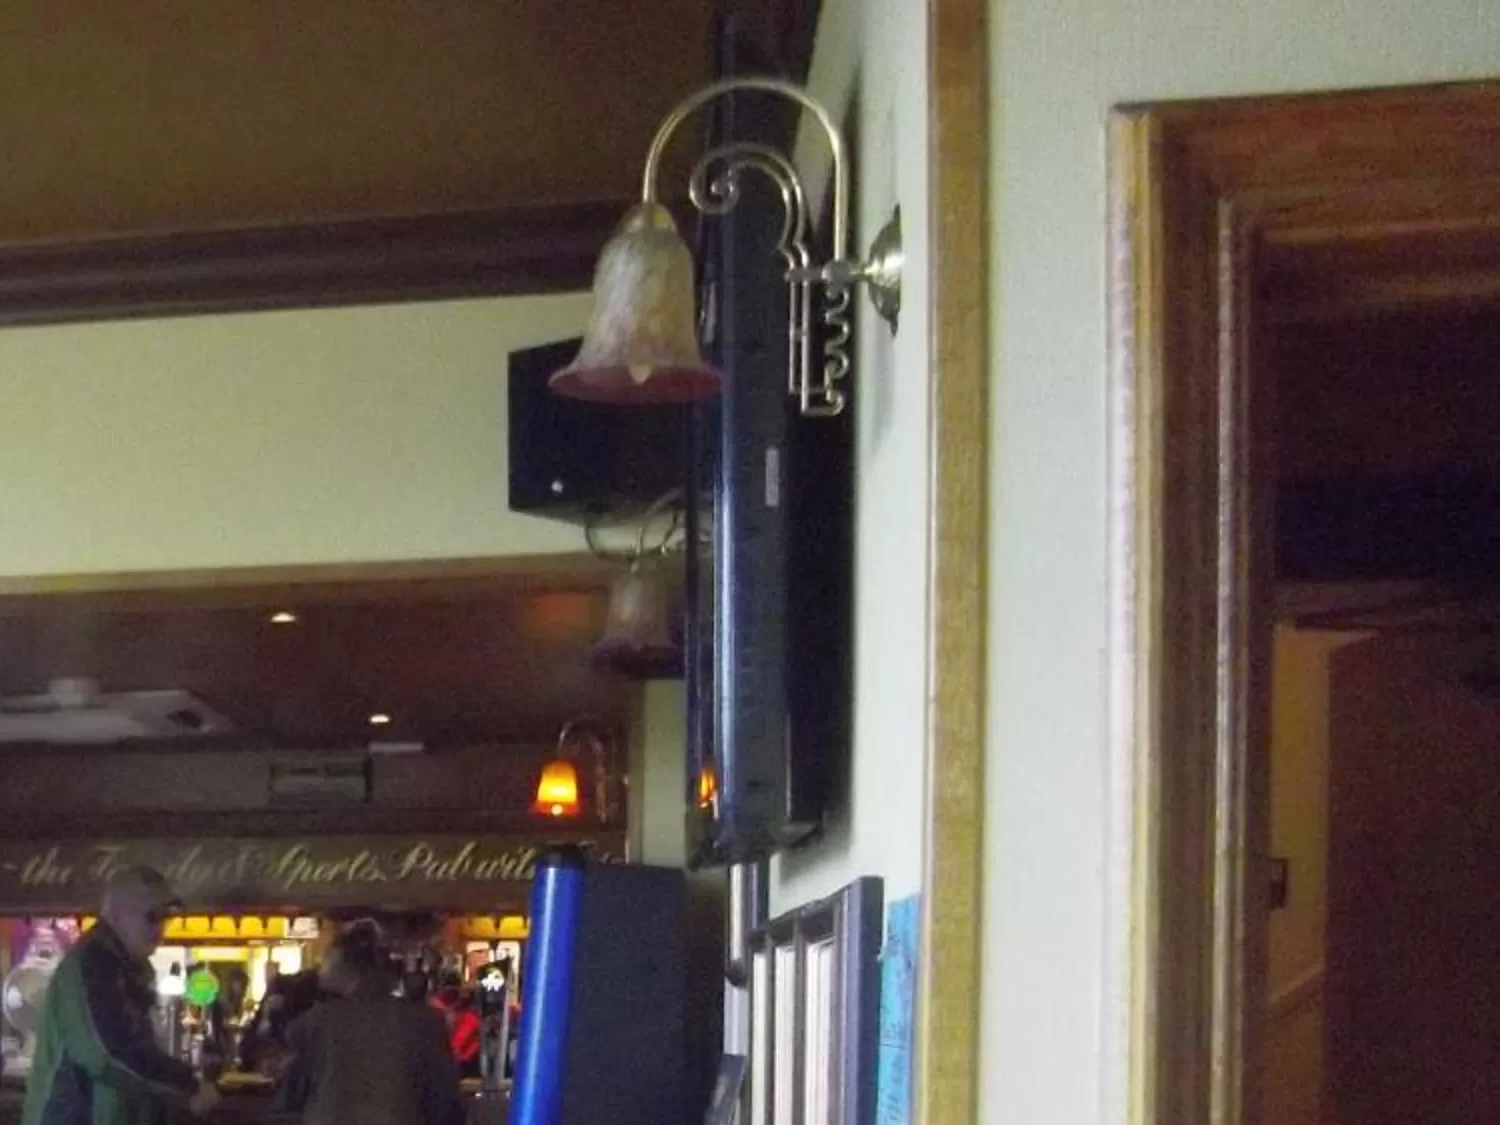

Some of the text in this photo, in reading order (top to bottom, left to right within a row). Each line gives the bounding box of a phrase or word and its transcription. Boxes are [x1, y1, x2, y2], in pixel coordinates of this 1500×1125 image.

[21, 847, 72, 885] the
[272, 844, 386, 891] Sports
[390, 841, 472, 881] Pub
